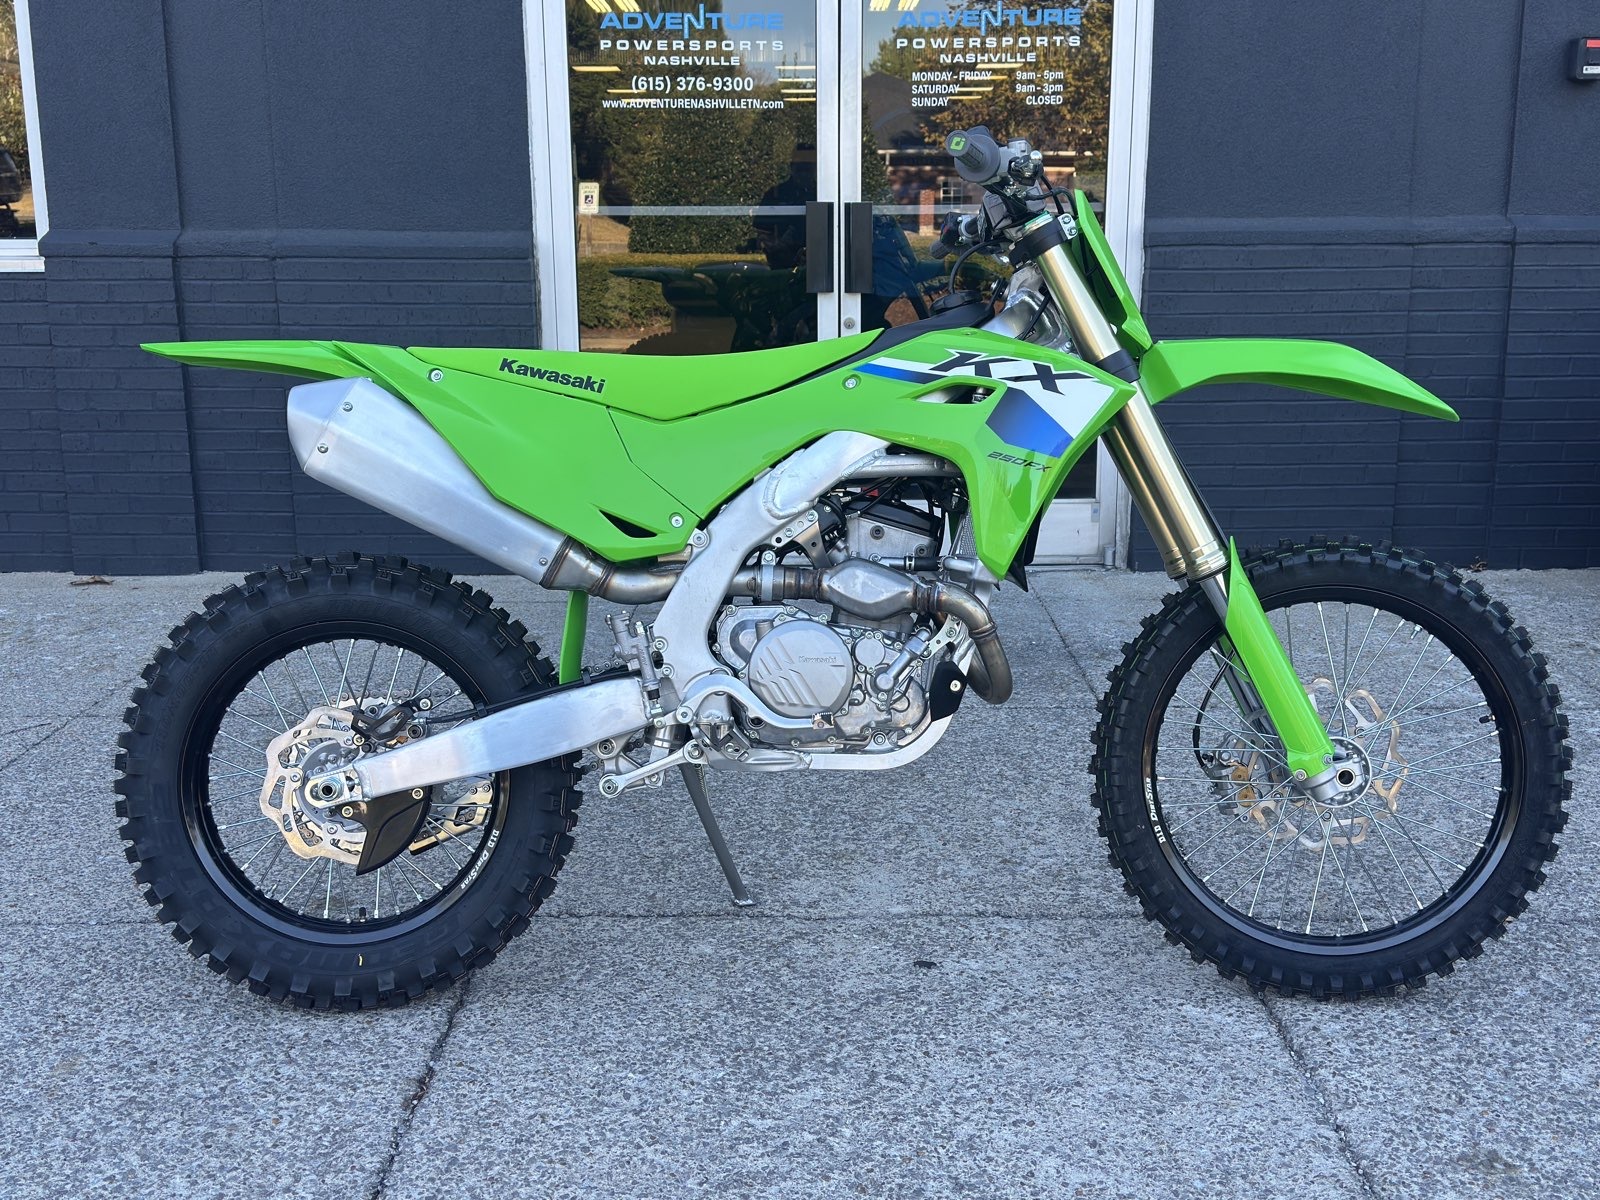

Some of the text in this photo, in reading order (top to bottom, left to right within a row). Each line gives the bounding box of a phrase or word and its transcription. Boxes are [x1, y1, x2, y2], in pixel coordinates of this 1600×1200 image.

[600, 4, 784, 39] ADVENTURE
[898, 0, 1081, 36] ADVENTURE
[600, 40, 784, 51] POWERSPORTS
[896, 36, 1081, 49] POWERSPORTS
[644, 56, 740, 66] NASHVILLE
[940, 53, 1036, 63] NASHVILLE
[1043, 70, 1064, 82] 5pm
[631, 76, 754, 93] (615) 376-9300
[912, 84, 960, 94] SATURDAY
[1043, 83, 1064, 94] 3pm
[602, 98, 784, 109] www.ADVENTURENASHVILLETN.com
[911, 95, 1063, 107] SUNDAY CLOSED
[499, 358, 605, 394] Kawasaki
[928, 351, 1095, 396] KX
